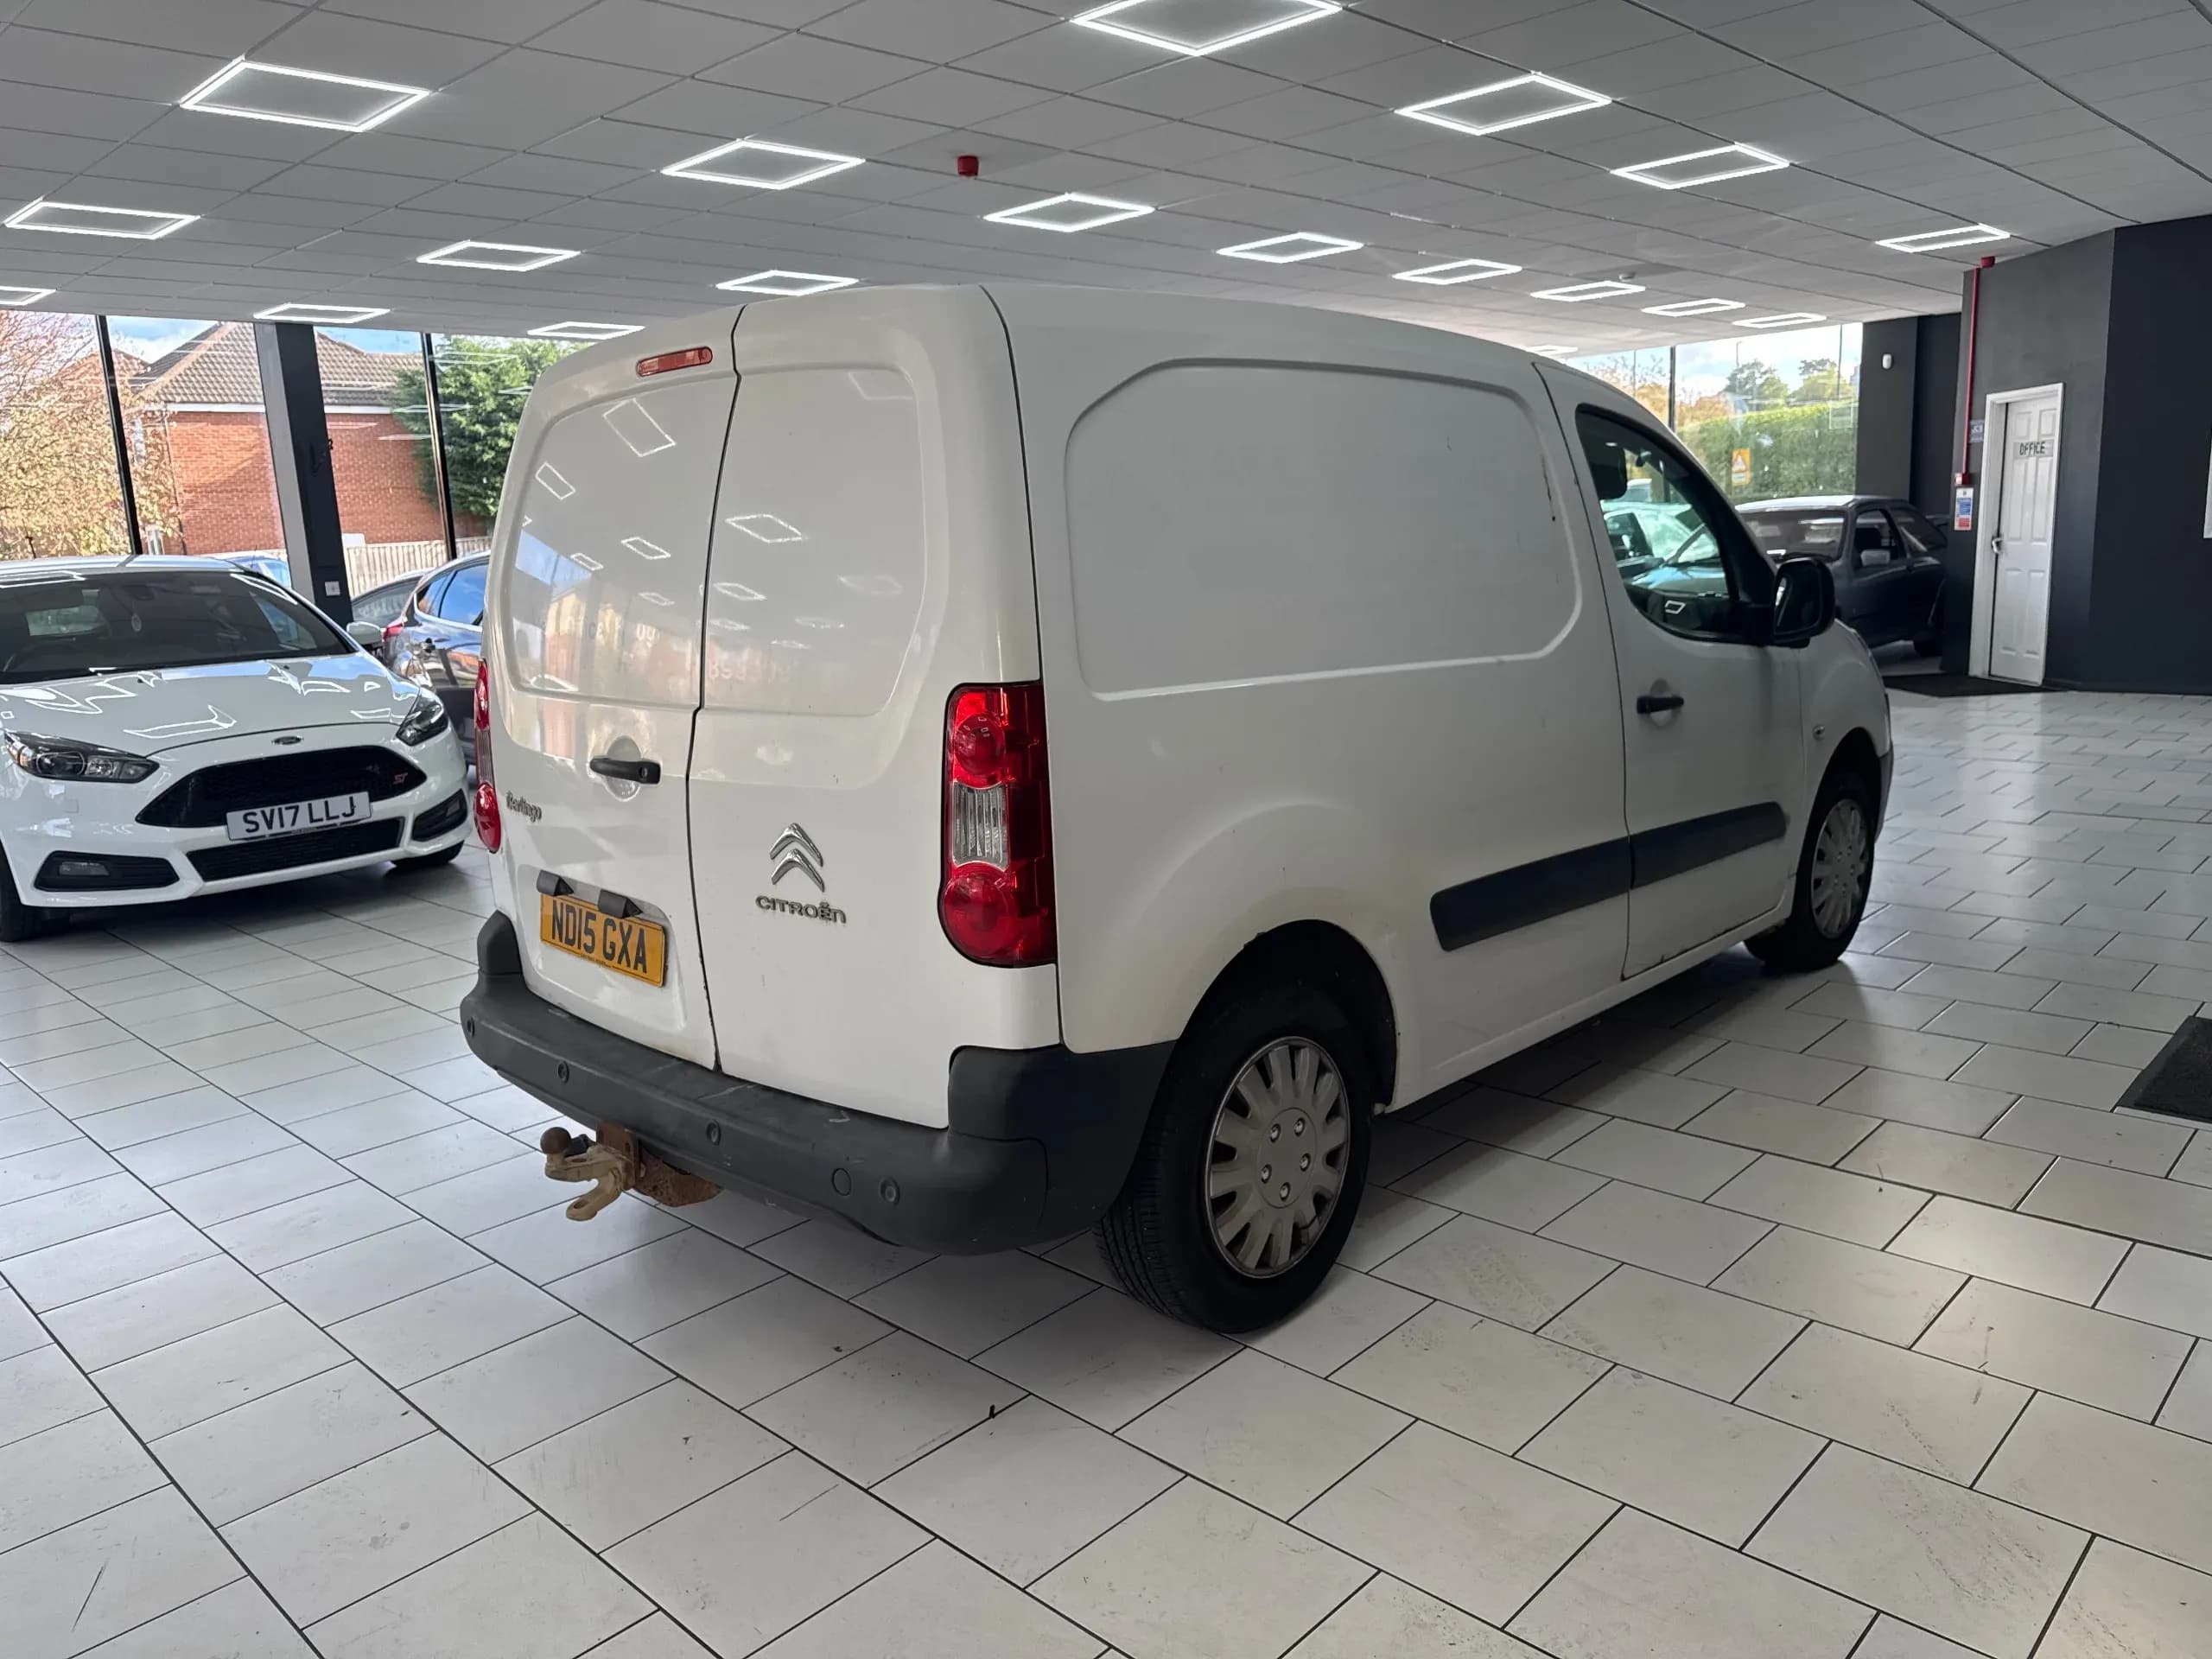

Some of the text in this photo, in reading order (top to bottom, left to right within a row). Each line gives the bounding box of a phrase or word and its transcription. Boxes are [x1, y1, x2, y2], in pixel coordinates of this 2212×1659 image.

[2019, 441, 2045, 455] OFFICE
[243, 796, 356, 834] SV17 LLJ
[551, 899, 647, 974] ND15 GXA
